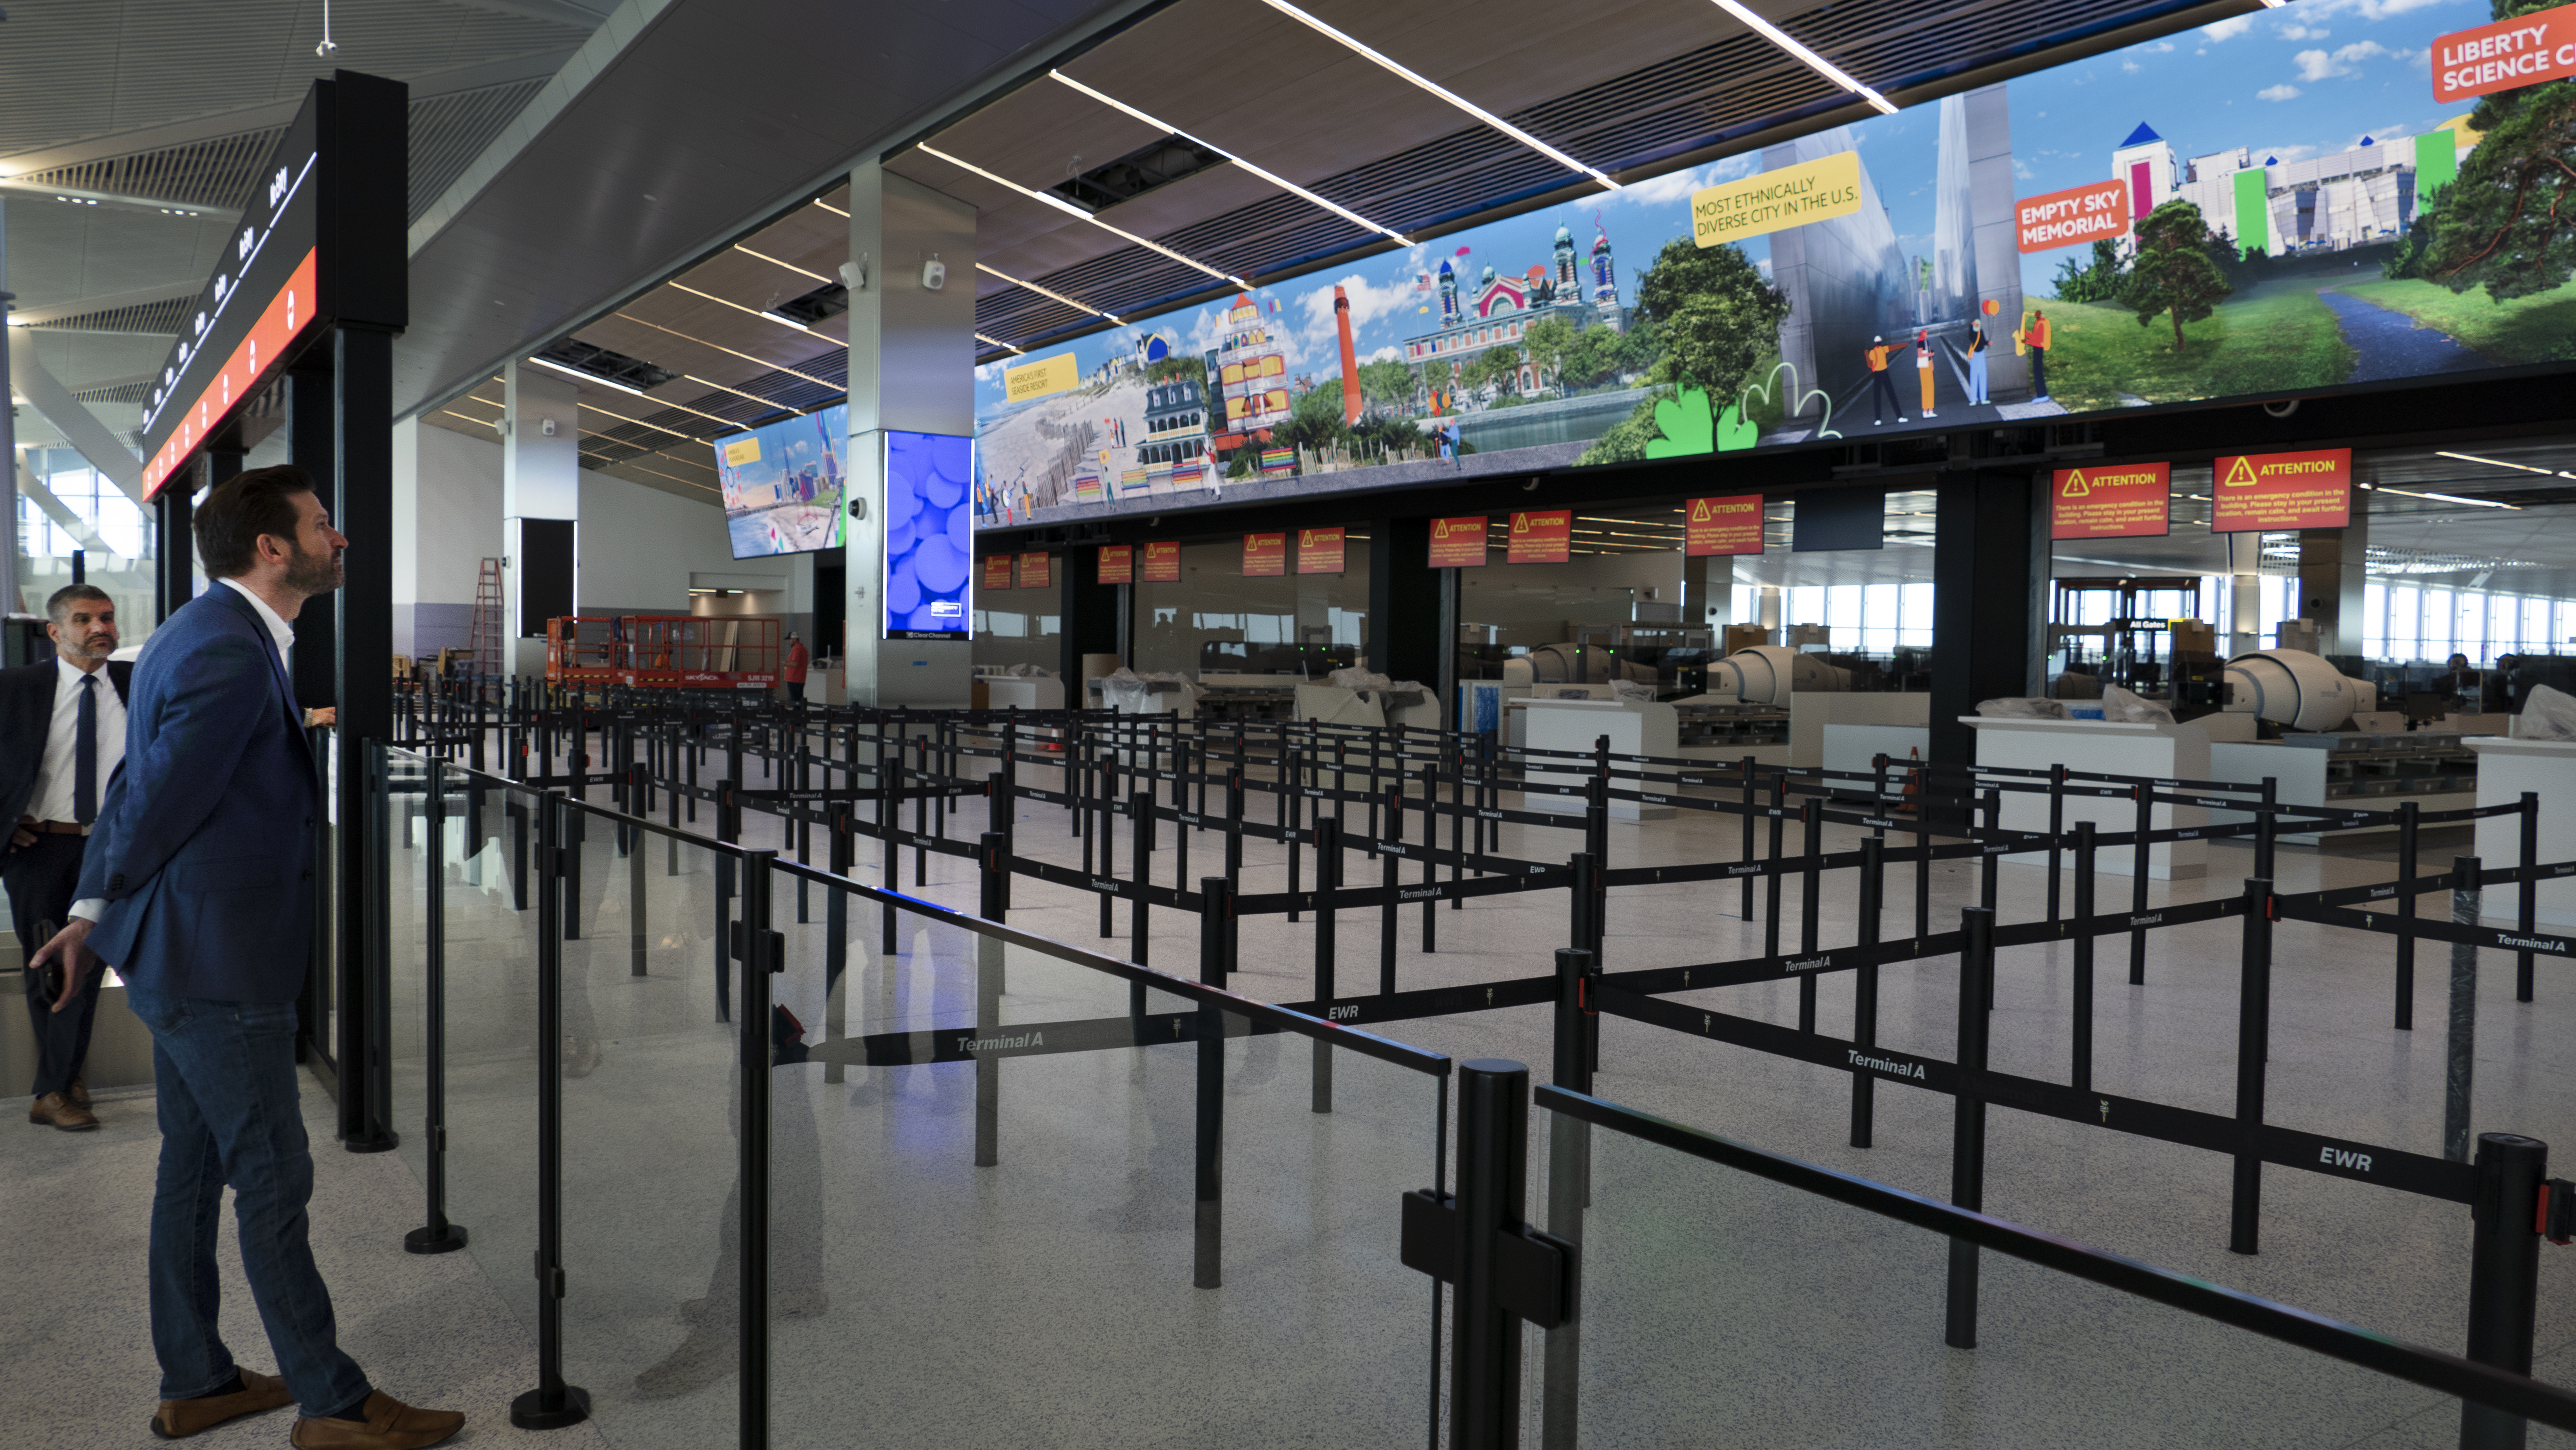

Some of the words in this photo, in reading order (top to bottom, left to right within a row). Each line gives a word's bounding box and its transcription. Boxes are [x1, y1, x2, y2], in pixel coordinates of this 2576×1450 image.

[2443, 24, 2548, 67] LIBERTY
[2443, 49, 2550, 92] SCIENCE
[1696, 197, 1731, 218] MOST
[1735, 175, 1815, 209] ETHNICALLY
[1697, 212, 1747, 236] DIVERSE
[1751, 203, 1780, 223] CITY
[1784, 200, 1798, 216] IN
[1801, 192, 1828, 211] THE
[1831, 186, 1858, 204] U.S.
[2021, 197, 2081, 226] EMPTY
[2084, 189, 2120, 212] SKY
[2022, 212, 2118, 245] MEMORIAL
[1010, 371, 1033, 385] AMERICA'S
[1034, 368, 1046, 378] FIRST
[1011, 383, 1030, 395] SEASIDE
[1030, 379, 1048, 391] RESORT
[2260, 460, 2335, 476] ATTENTION
[2092, 473, 2156, 487] ATTENTION
[2291, 490, 2323, 498] condition
[1712, 503, 1755, 514] ATTENTION
[2314, 498, 2340, 506] present
[1449, 523, 1481, 533] ATTENTION
[1530, 517, 1565, 526] ATTENTION
[2142, 620, 2165, 628] Gates
[1030, 790, 1042, 798] Terminal
[1179, 814, 1195, 822] Terminal
[1478, 810, 1498, 818] Terminal
[1862, 817, 1888, 826] Terminal
[1285, 830, 1296, 838] EWR
[913, 836, 928, 846] Terminal
[1377, 842, 1401, 853] Terminal
[1728, 865, 1756, 874] Terminal
[1092, 878, 1114, 891] Terminal
[1114, 884, 1119, 892] A
[1400, 887, 1434, 899] Terminal
[1435, 887, 1442, 895] A
[2370, 887, 2390, 897] Terminal
[2130, 914, 2157, 926] Terminal
[2157, 913, 2162, 922] A
[2497, 934, 2554, 950] Terminal
[2555, 942, 2566, 951] A
[1786, 957, 1823, 972] Terminal
[1823, 956, 1830, 966] A
[1328, 1005, 1359, 1020] EWR
[958, 1032, 1029, 1052] Terminal
[1030, 1031, 1043, 1047] A
[1848, 1049, 1912, 1077] Terminal
[1913, 1064, 1925, 1080] A
[2319, 1146, 2373, 1172] EWR
